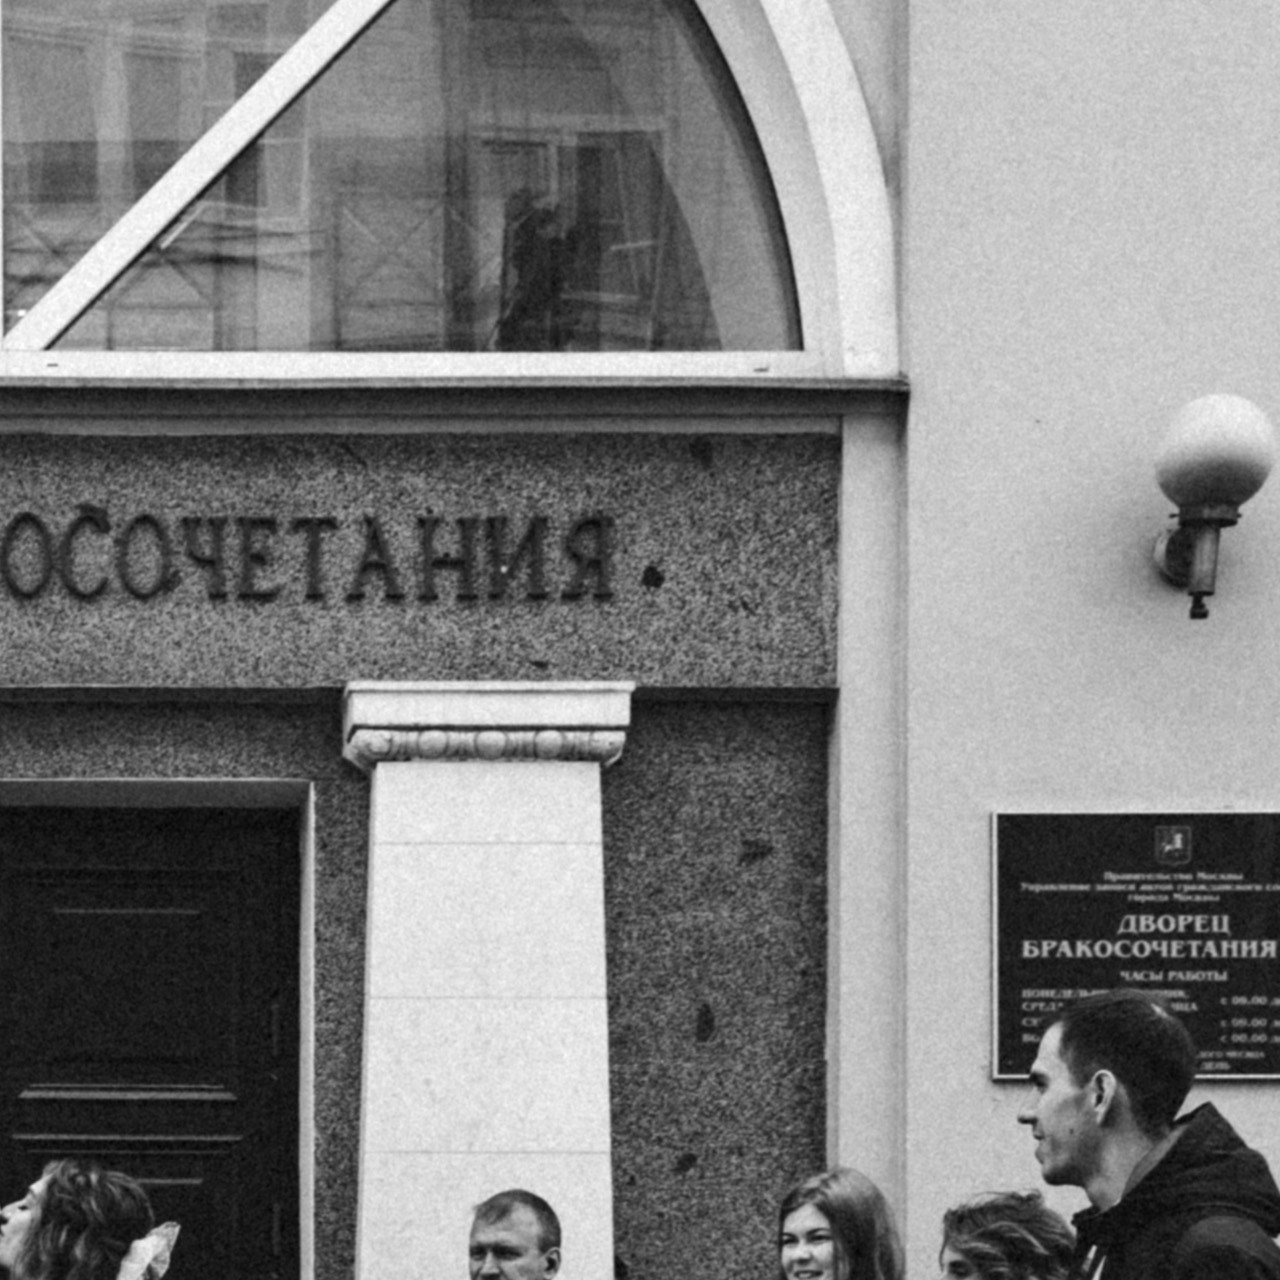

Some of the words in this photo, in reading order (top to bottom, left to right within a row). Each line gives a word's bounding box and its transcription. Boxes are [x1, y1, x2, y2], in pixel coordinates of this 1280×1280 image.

[1117, 914, 1231, 936] ДВОРЕЦ
[1022, 940, 1277, 958] БРАКОСОЧЕТАНИЯ
[1120, 971, 1163, 982] ЧАСЫ
[1167, 971, 1228, 982] РАБОТЫ
